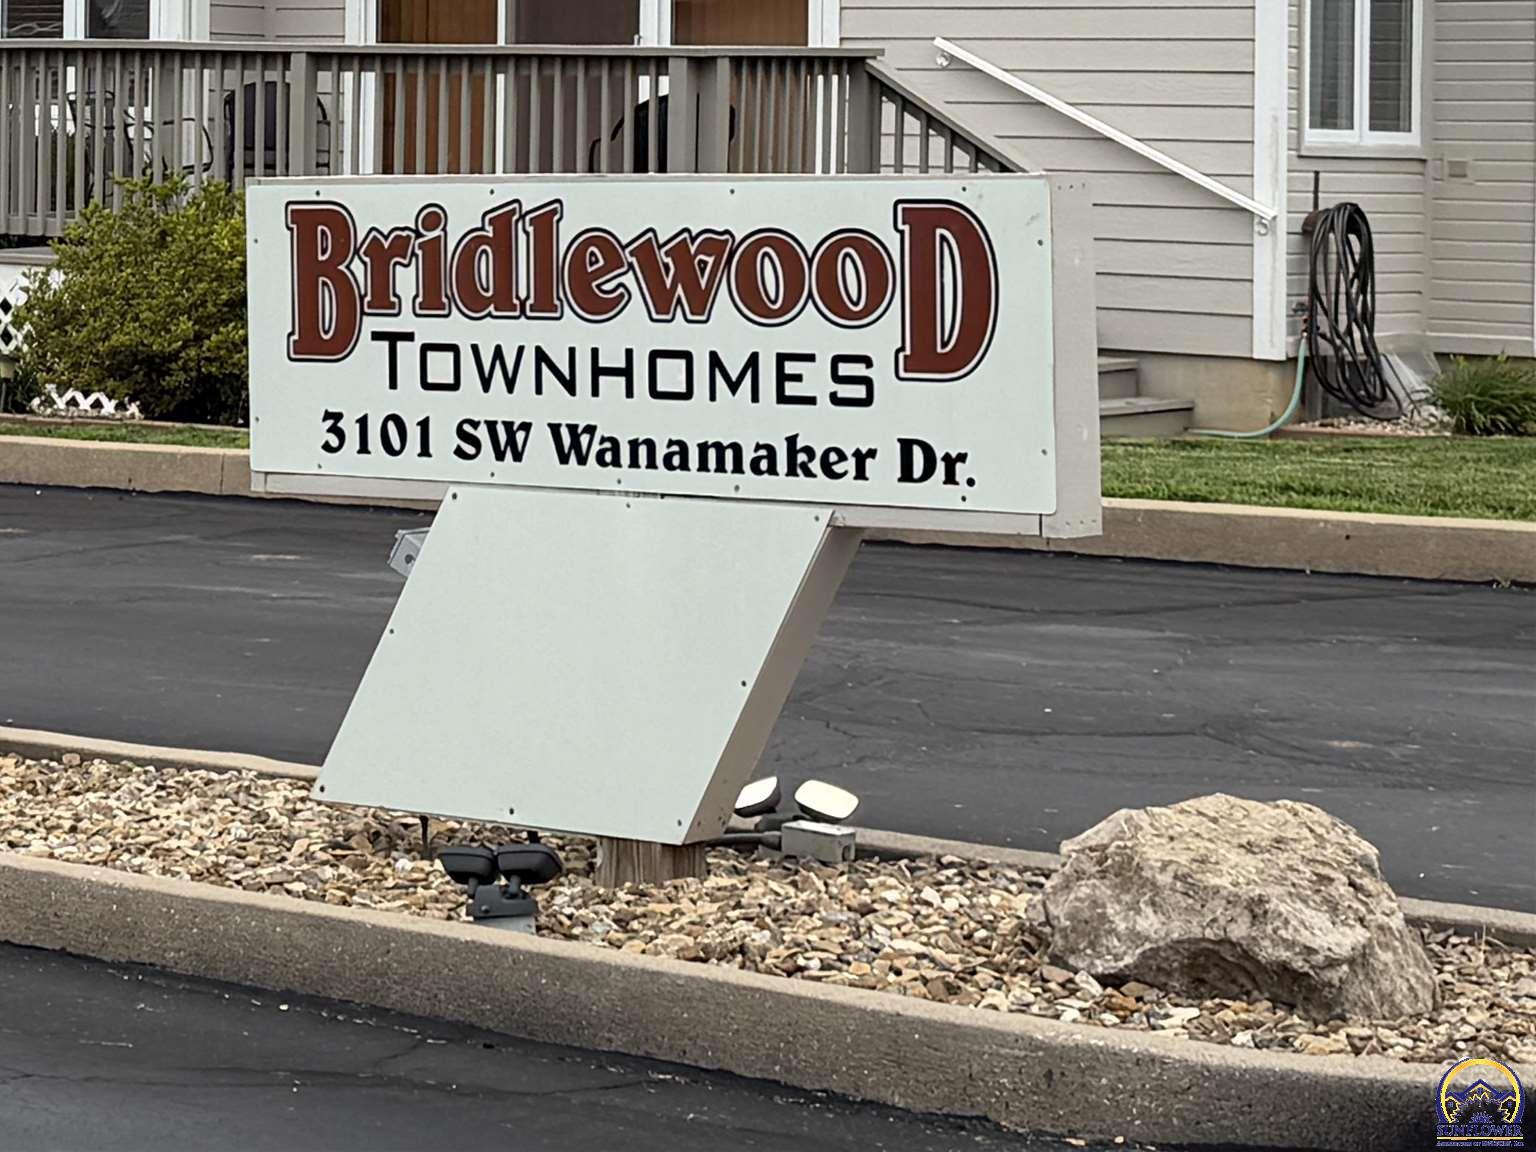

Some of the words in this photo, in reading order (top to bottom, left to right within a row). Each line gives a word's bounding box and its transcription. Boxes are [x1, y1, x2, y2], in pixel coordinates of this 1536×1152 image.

[320, 409, 433, 457] 3101
[453, 418, 533, 463] SW
[547, 422, 878, 482] Wanamaker
[897, 437, 976, 488] Dr.
